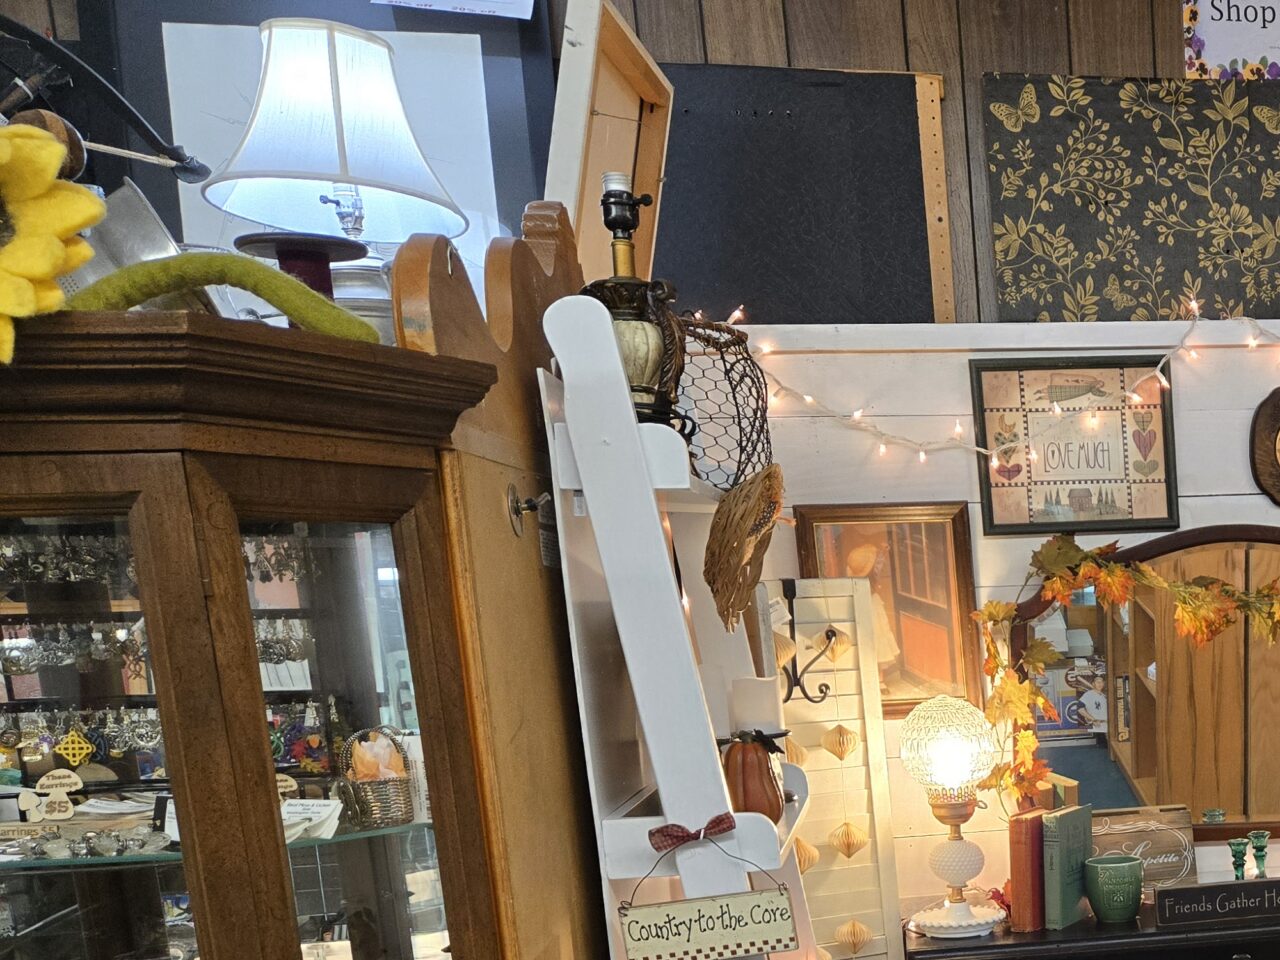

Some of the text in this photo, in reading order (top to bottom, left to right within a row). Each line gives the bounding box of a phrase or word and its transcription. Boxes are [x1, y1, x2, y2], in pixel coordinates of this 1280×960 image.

[1210, 0, 1276, 28] Shop
[1043, 441, 1111, 472] LOVE MUCH
[45, 800, 70, 815] $5
[1165, 898, 1212, 917] Friends
[1216, 892, 1261, 913] Gather
[627, 904, 791, 942] Country to the Core
